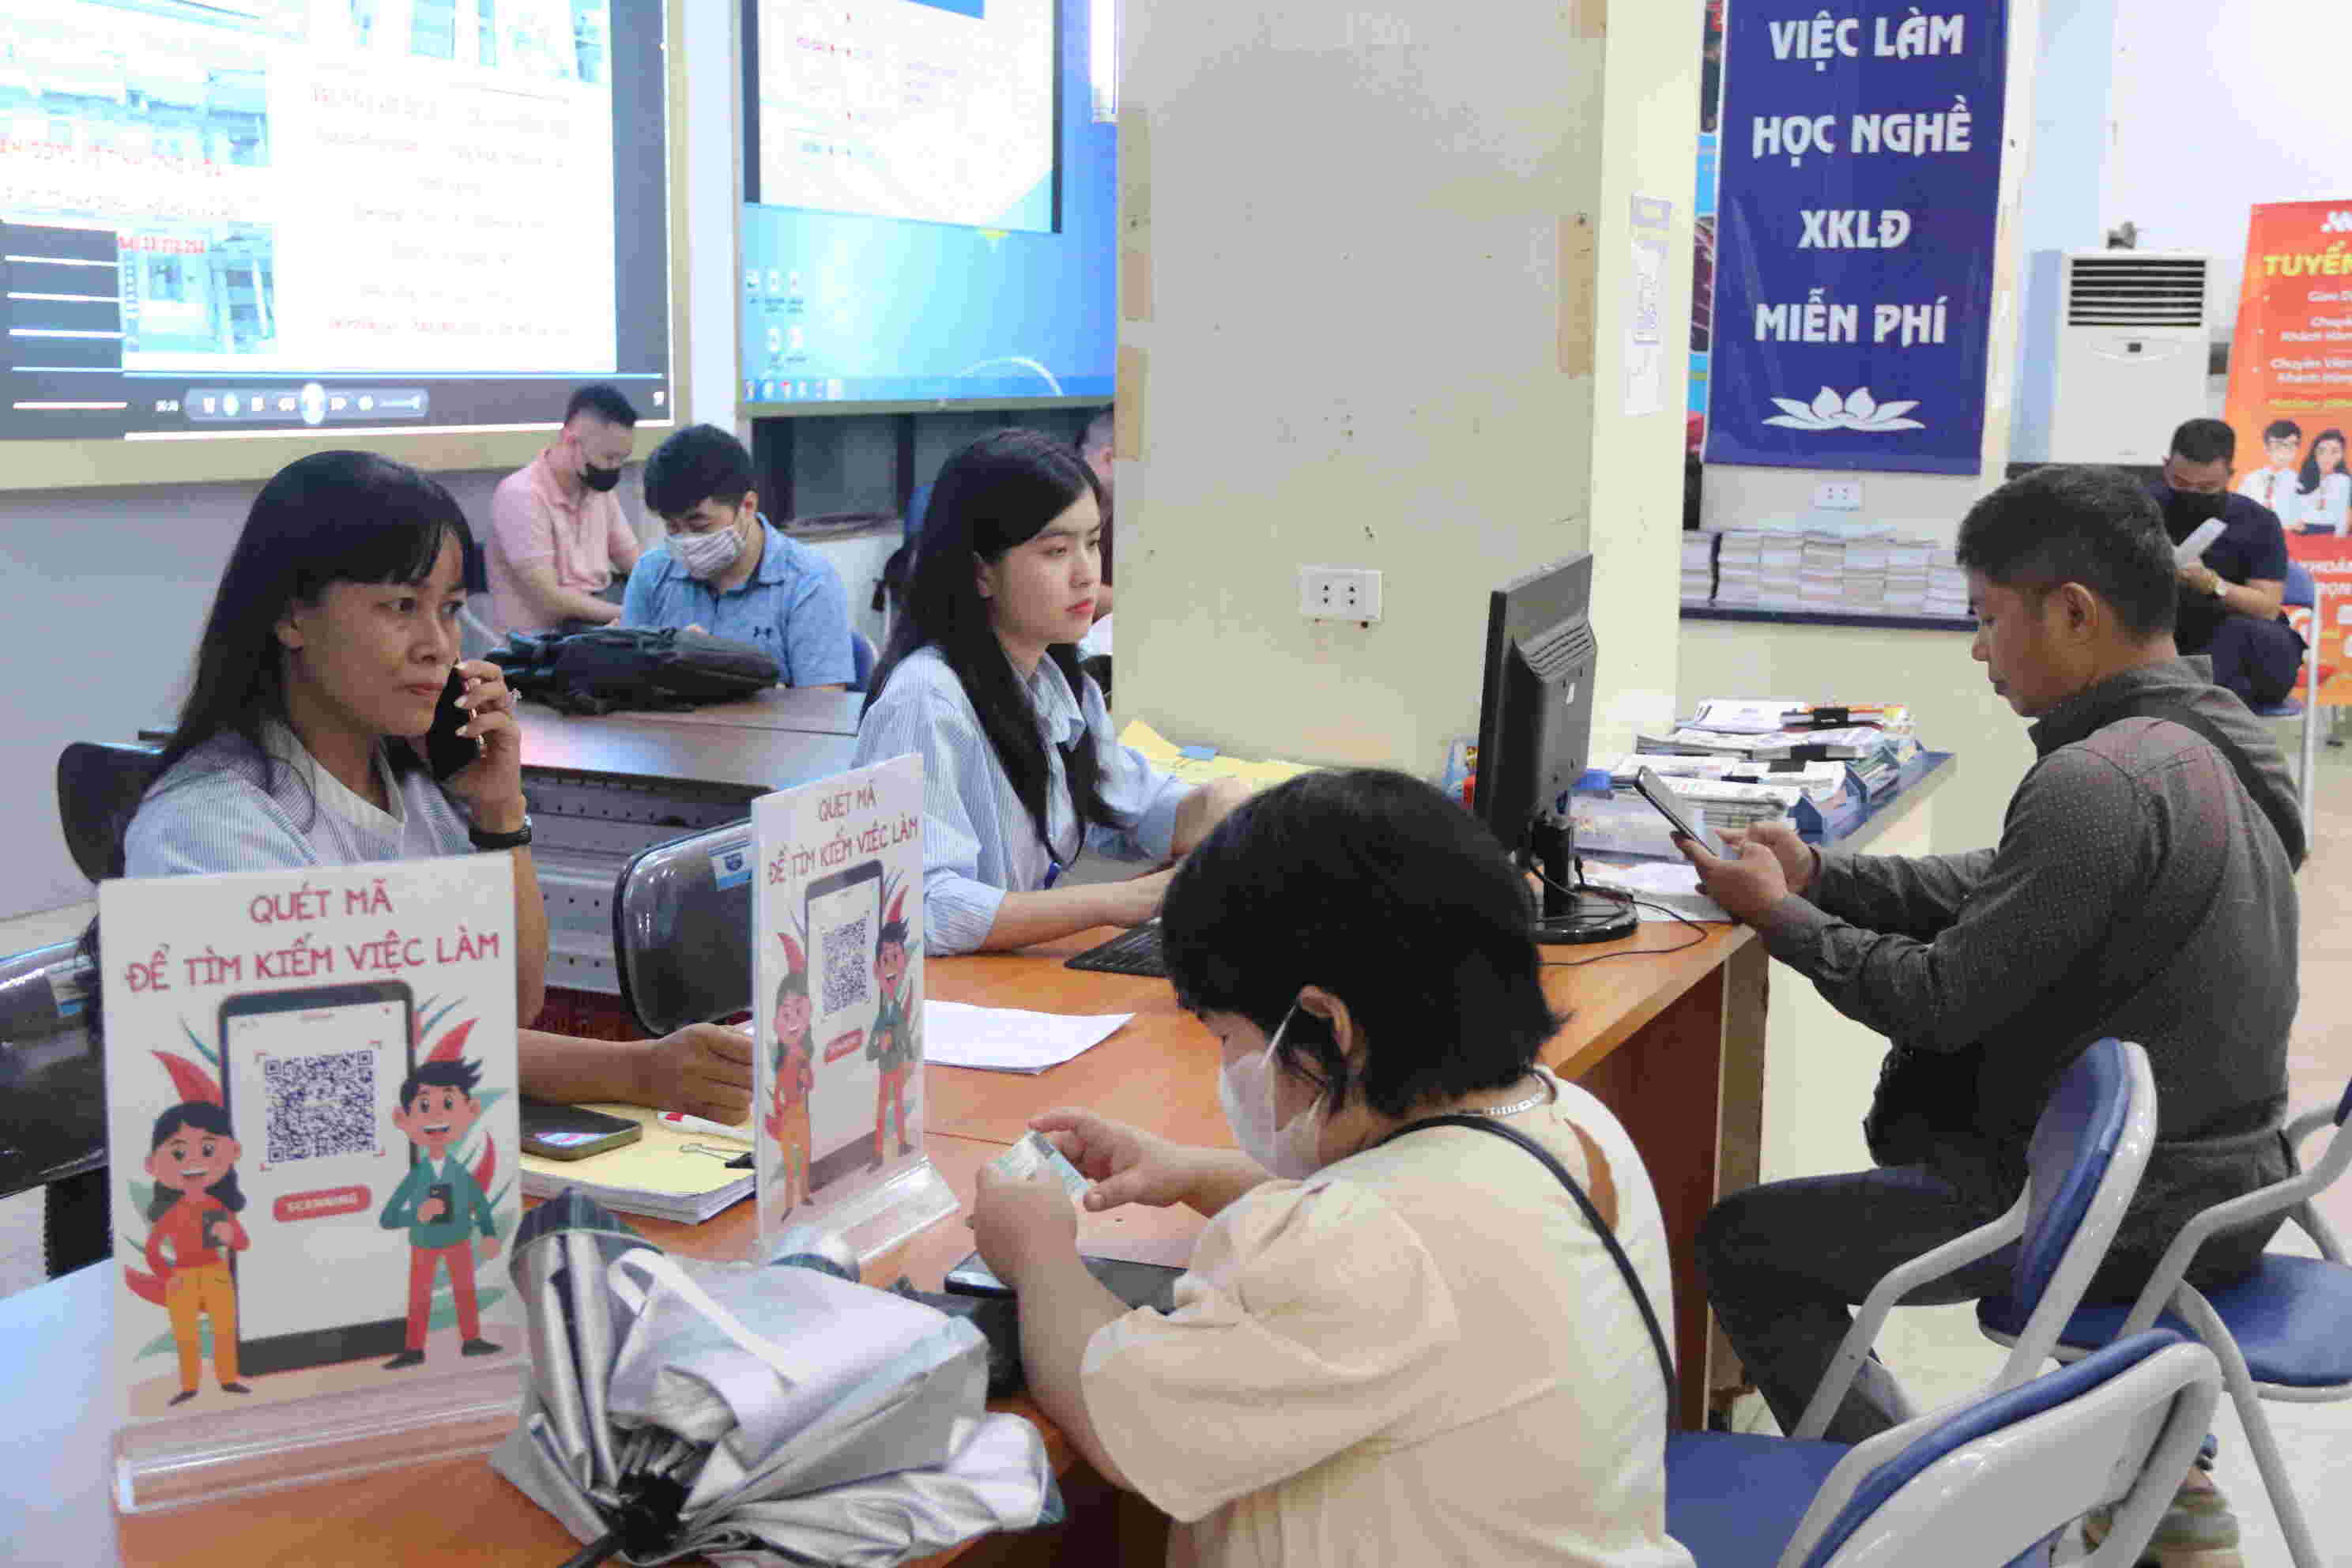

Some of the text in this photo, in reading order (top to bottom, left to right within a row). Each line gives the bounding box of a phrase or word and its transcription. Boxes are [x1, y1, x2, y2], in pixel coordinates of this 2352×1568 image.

[1770, 7, 1964, 71] VIỆC LÀM
[1752, 95, 1972, 167] HỌC NGHỀ
[1798, 210, 1911, 249] XKLĐ
[1755, 288, 1948, 347] MIỄN PHÍ
[817, 778, 878, 822] QUÉT MÃ
[791, 843, 816, 876] TÌM
[820, 824, 854, 869] KIẾM
[856, 820, 889, 855] VIỆC
[891, 812, 919, 845] LÀM
[249, 878, 394, 924] QUÉT MÃ
[125, 925, 500, 993] ĐỂ TÌM KIẾM VIỆC LÀM
